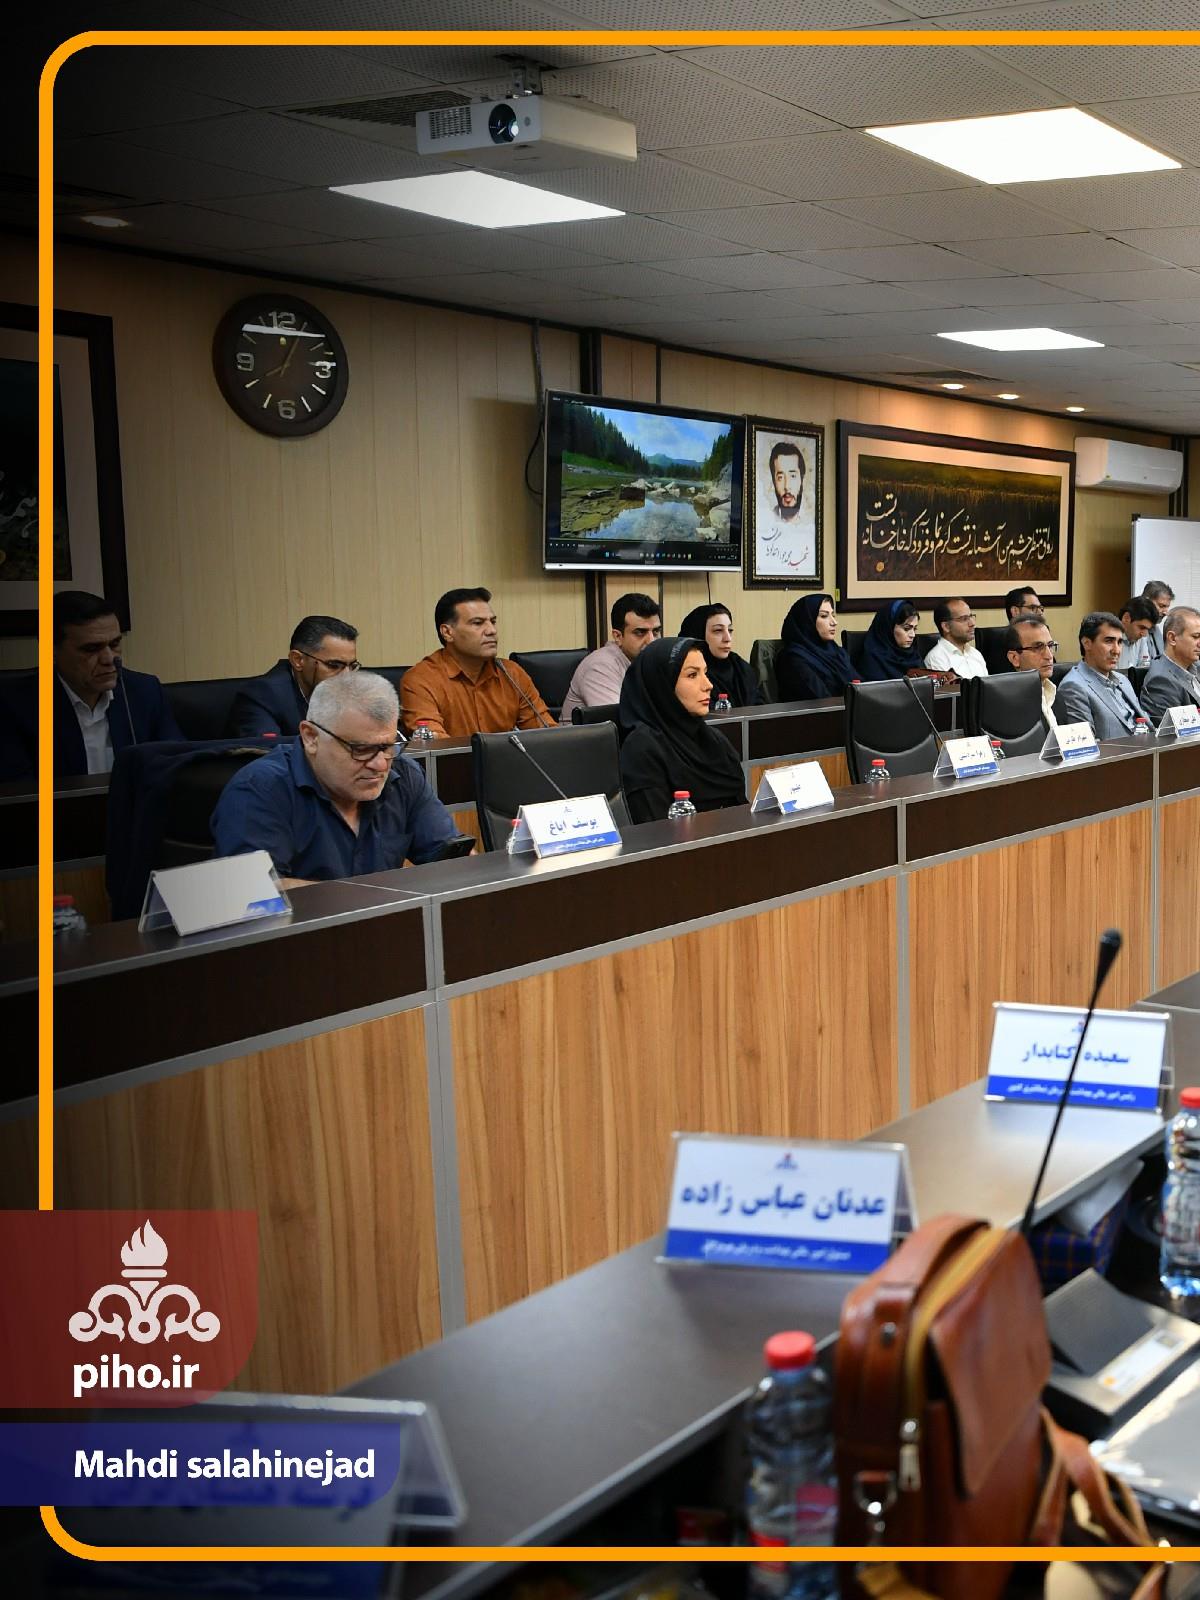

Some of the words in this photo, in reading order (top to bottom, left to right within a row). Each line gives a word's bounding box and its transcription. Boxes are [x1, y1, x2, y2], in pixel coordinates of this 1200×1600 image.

[268, 311, 297, 330] 12
[236, 352, 255, 371] 9
[315, 360, 332, 379] 3
[277, 400, 296, 419] 6
[1083, 1048, 1130, 1067] سعیده
[681, 1180, 734, 1215] زاده
[739, 1184, 807, 1218] عباس
[813, 1188, 886, 1220] عدنان
